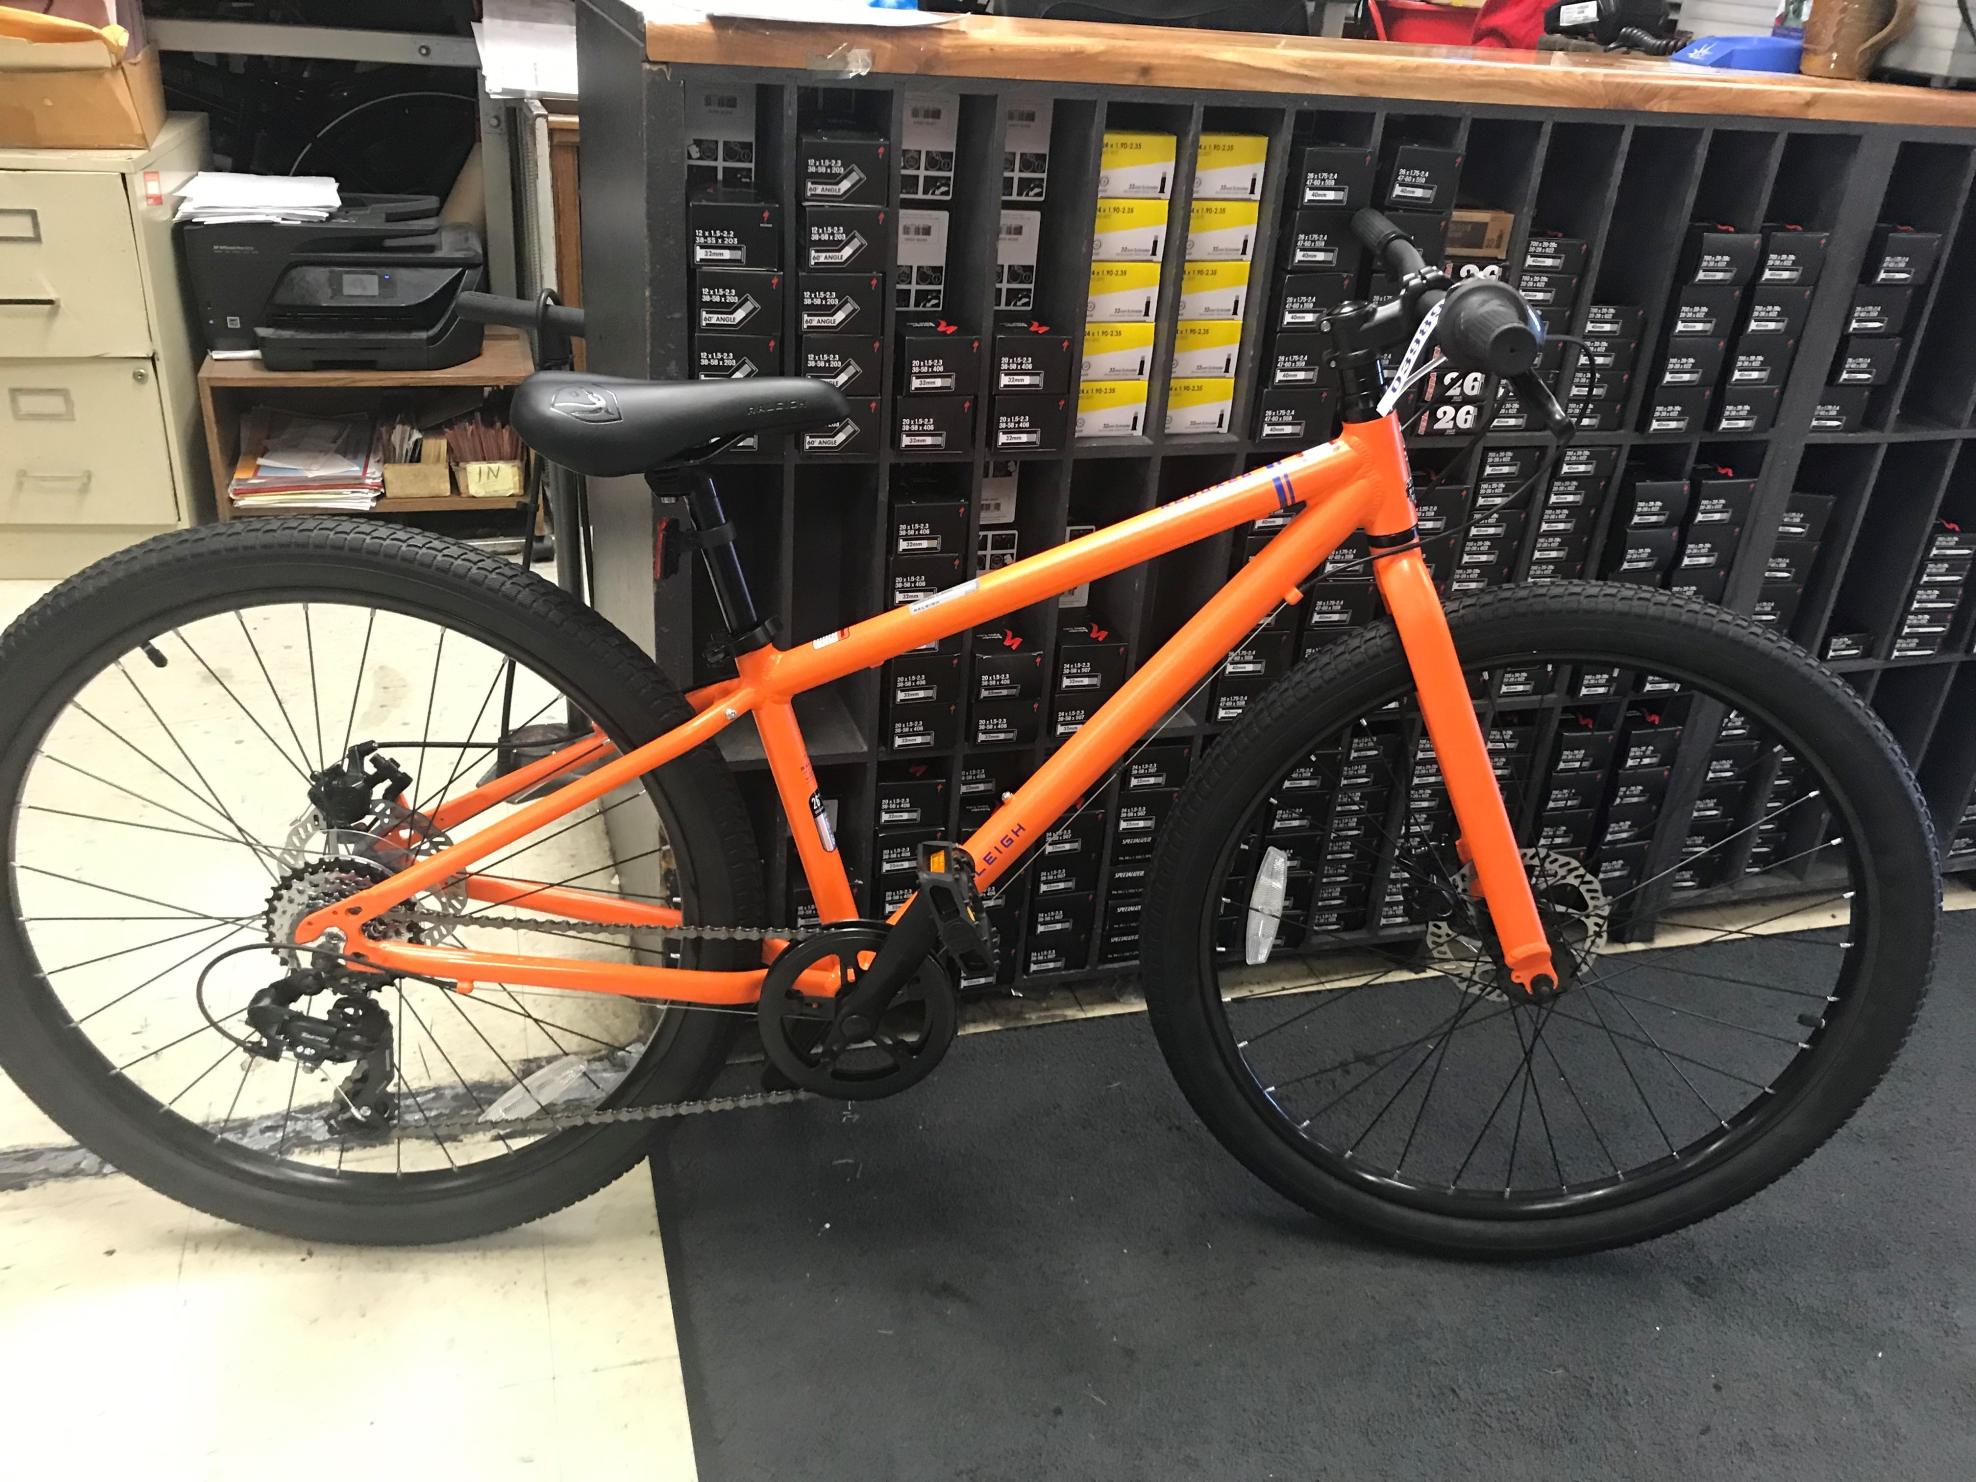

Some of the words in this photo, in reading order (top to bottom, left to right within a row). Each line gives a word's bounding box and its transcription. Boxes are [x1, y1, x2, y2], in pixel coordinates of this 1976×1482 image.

[808, 159, 815, 167] 12
[821, 186, 841, 194] ANGLE
[1444, 372, 1483, 396] 26
[1434, 405, 1474, 429] 26
[975, 824, 1026, 877] LEIGH
